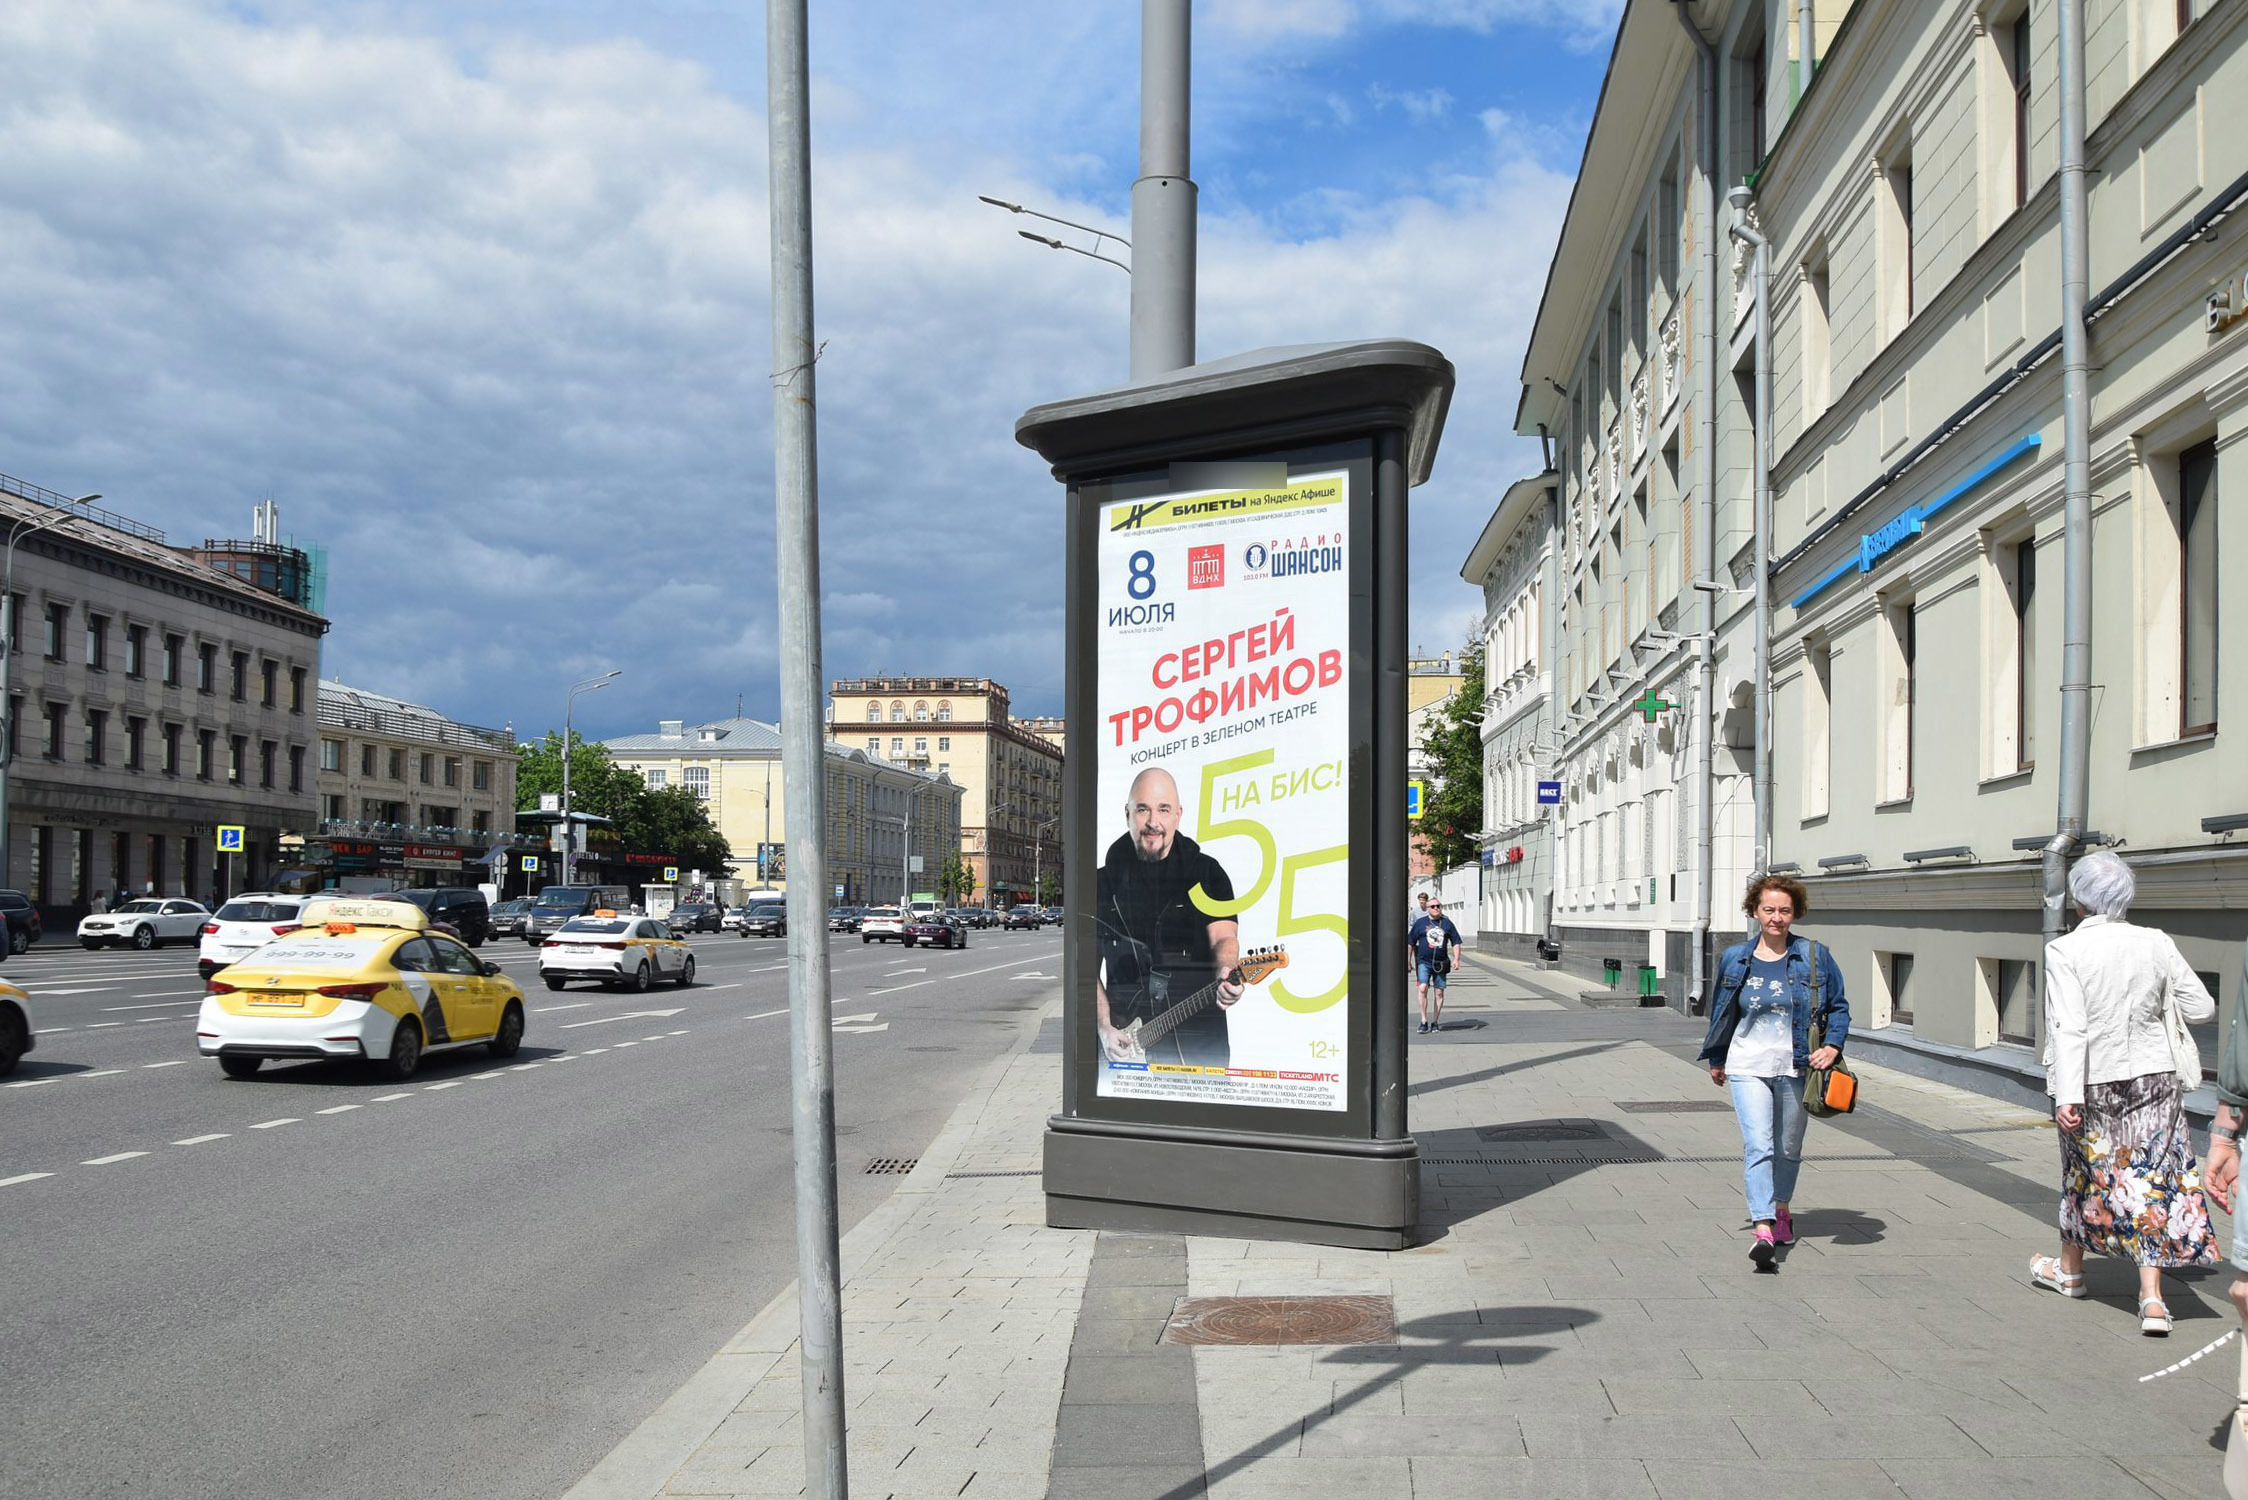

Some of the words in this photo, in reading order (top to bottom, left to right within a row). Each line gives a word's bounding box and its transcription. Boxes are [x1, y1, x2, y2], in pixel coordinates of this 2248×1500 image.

[1172, 497, 1247, 517] БИЛЕТЫ
[1249, 498, 1262, 508] на
[1264, 490, 1298, 506] Яндекс
[1300, 486, 1336, 501] Афише
[1271, 532, 1342, 551] РАДИО
[1127, 549, 1157, 600] 8
[1271, 546, 1342, 577] ШАНСОН
[1192, 573, 1220, 584] ВДНХ
[1108, 602, 1175, 627] ИЮЛЯ
[1152, 606, 1295, 690] СЕРГЕЙ
[1109, 648, 1343, 747] ТРОФИМОВ
[1130, 737, 1189, 765] КОНЦЕРТ
[1191, 735, 1200, 748] В
[1202, 715, 1266, 746] ЗЕЛЕНОМ
[1269, 701, 1318, 725] ТЕАТРЕ
[1222, 783, 1261, 813] НА
[1270, 760, 1342, 802] БИС!
[1308, 1040, 1340, 1059] 12+
[1313, 1073, 1340, 1083] МТС
